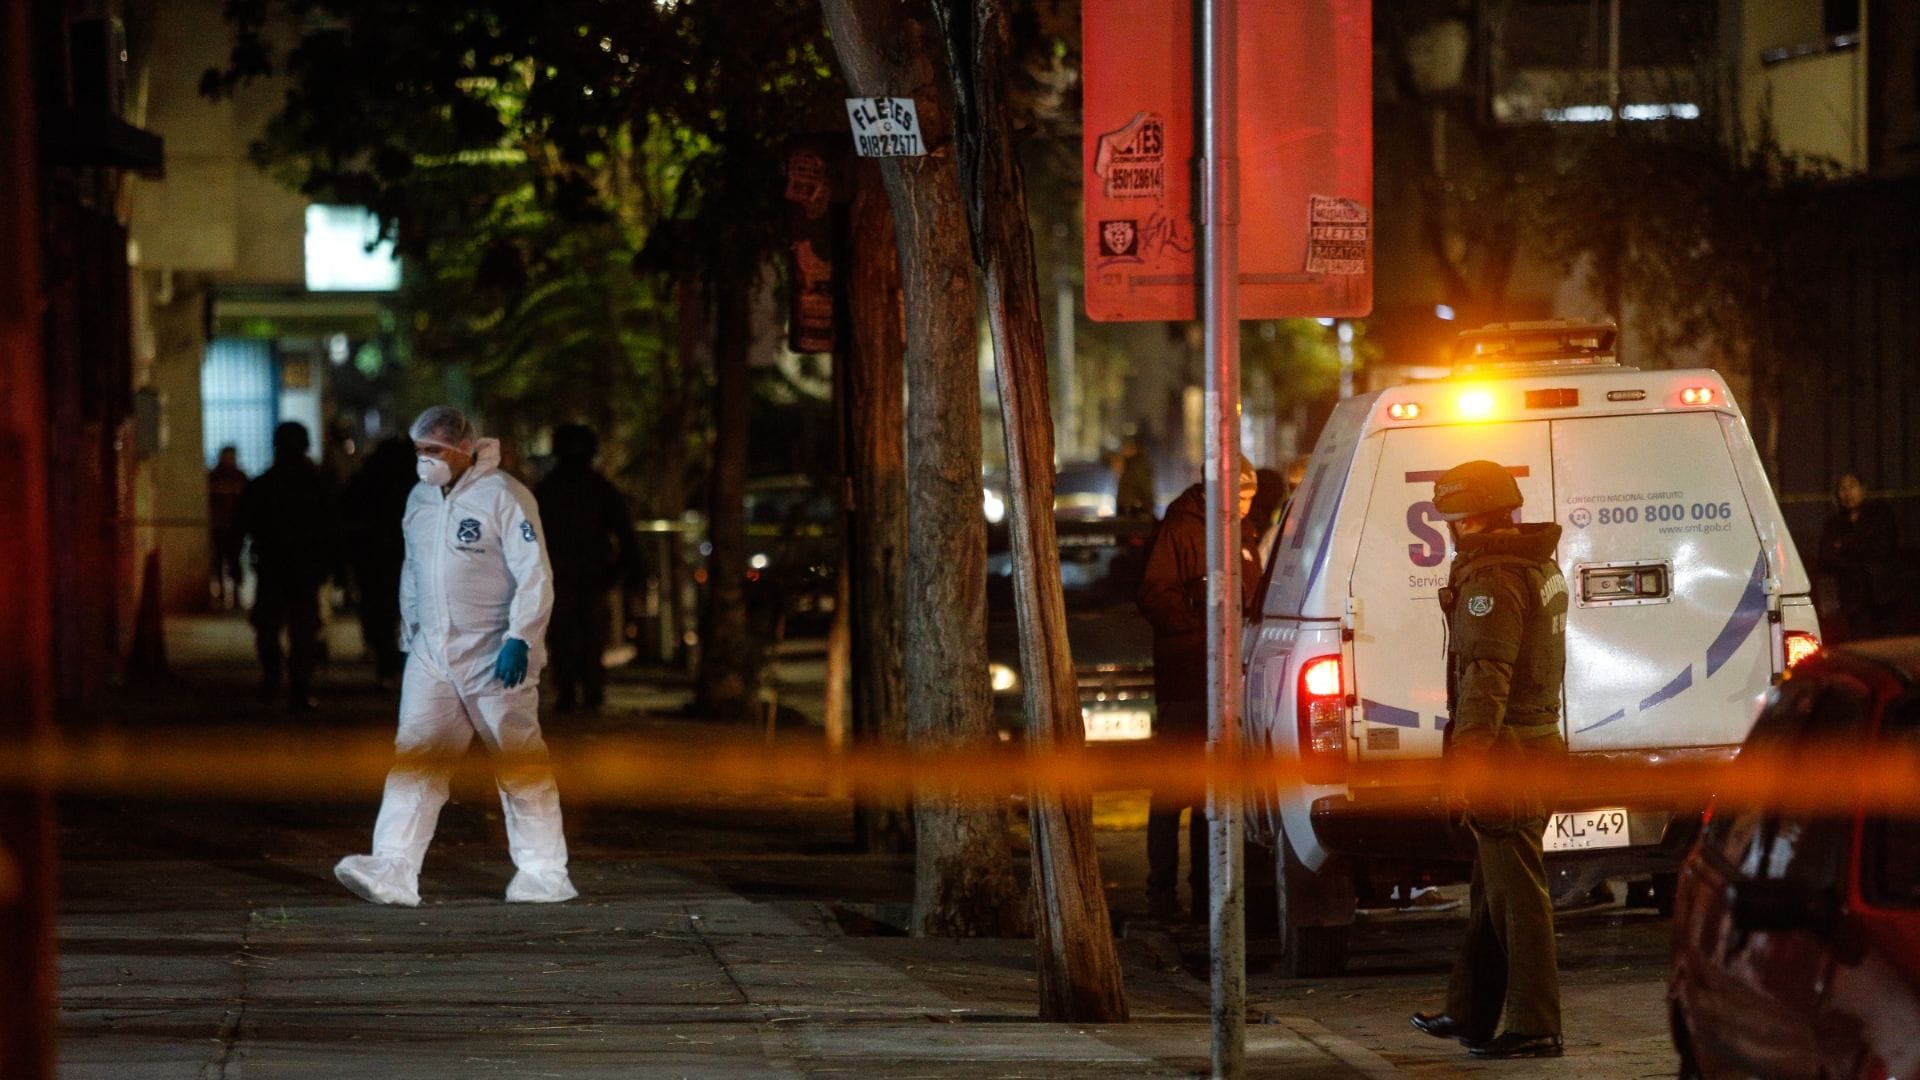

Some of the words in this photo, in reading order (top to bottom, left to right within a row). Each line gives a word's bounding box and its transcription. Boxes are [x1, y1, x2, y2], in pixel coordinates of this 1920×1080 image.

[853, 98, 912, 131] FLETES
[1314, 229, 1364, 240] FLETES
[1566, 495, 1606, 504] CONTACTO
[1607, 493, 1645, 502] NACIONAL
[1647, 491, 1684, 500] GRATUITO
[1598, 506, 1638, 525] 800
[1645, 504, 1685, 522] 800
[1691, 502, 1731, 520] 006
[1409, 575, 1448, 588] Servici
